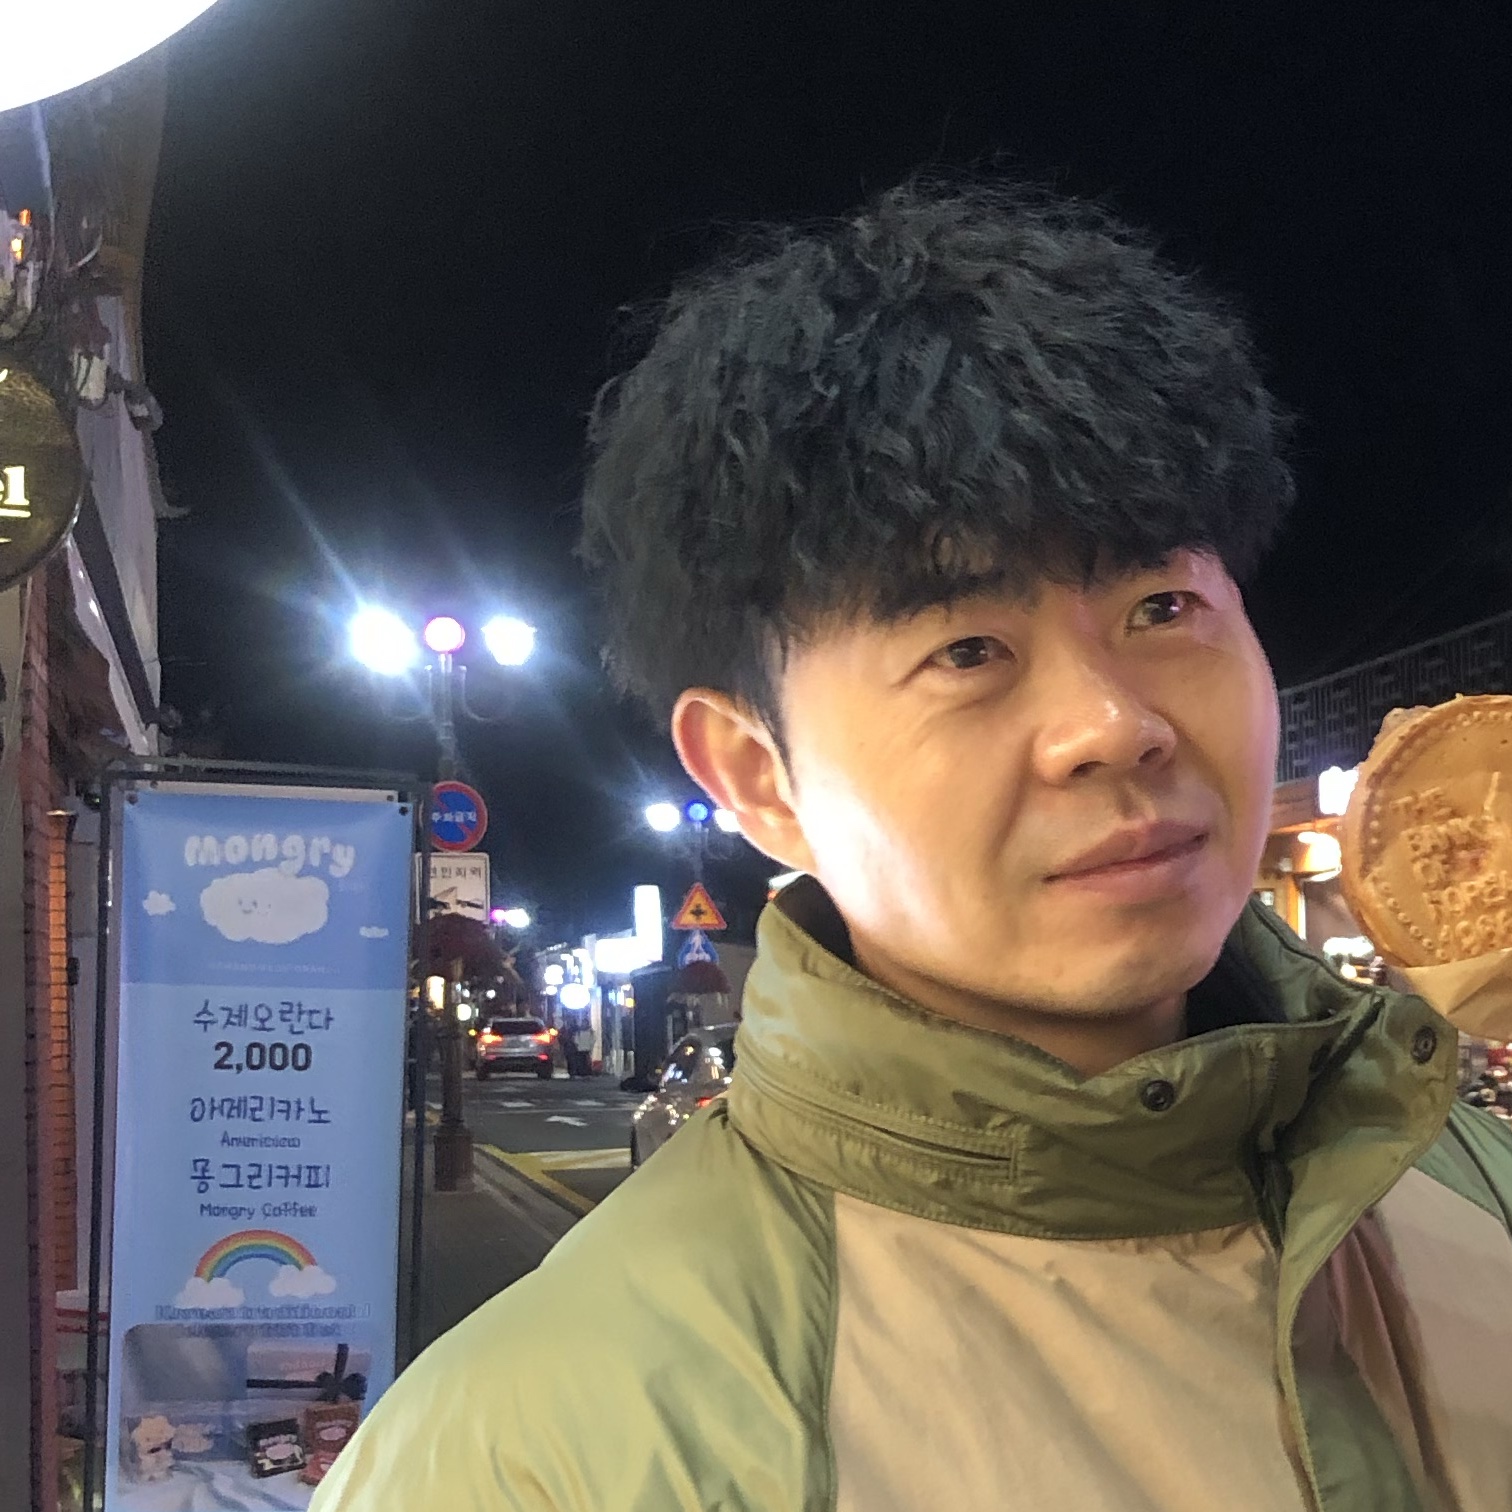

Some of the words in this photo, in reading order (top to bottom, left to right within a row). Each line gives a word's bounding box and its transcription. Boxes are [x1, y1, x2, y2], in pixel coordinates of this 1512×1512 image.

[193, 999, 334, 1035] 수제오란다
[213, 1041, 312, 1074] 2,000
[190, 1095, 331, 1124] 아메리카노
[190, 1158, 331, 1193] 몽그리커피
